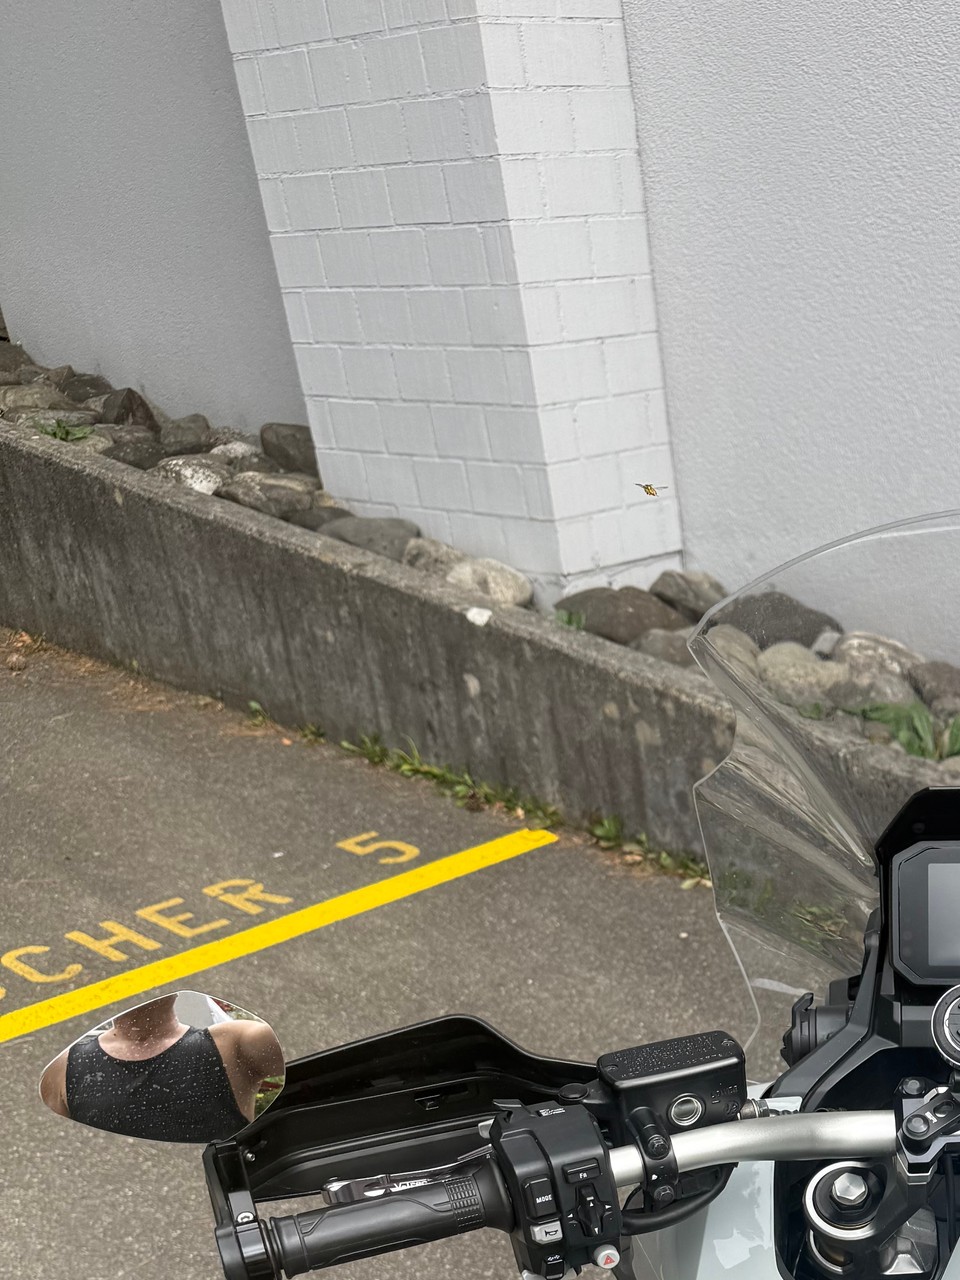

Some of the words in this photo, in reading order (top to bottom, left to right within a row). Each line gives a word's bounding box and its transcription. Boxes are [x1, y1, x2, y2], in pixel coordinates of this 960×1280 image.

[0, 878, 294, 1000] CHER
[336, 831, 421, 864] 5
[535, 1194, 553, 1204] MODE
